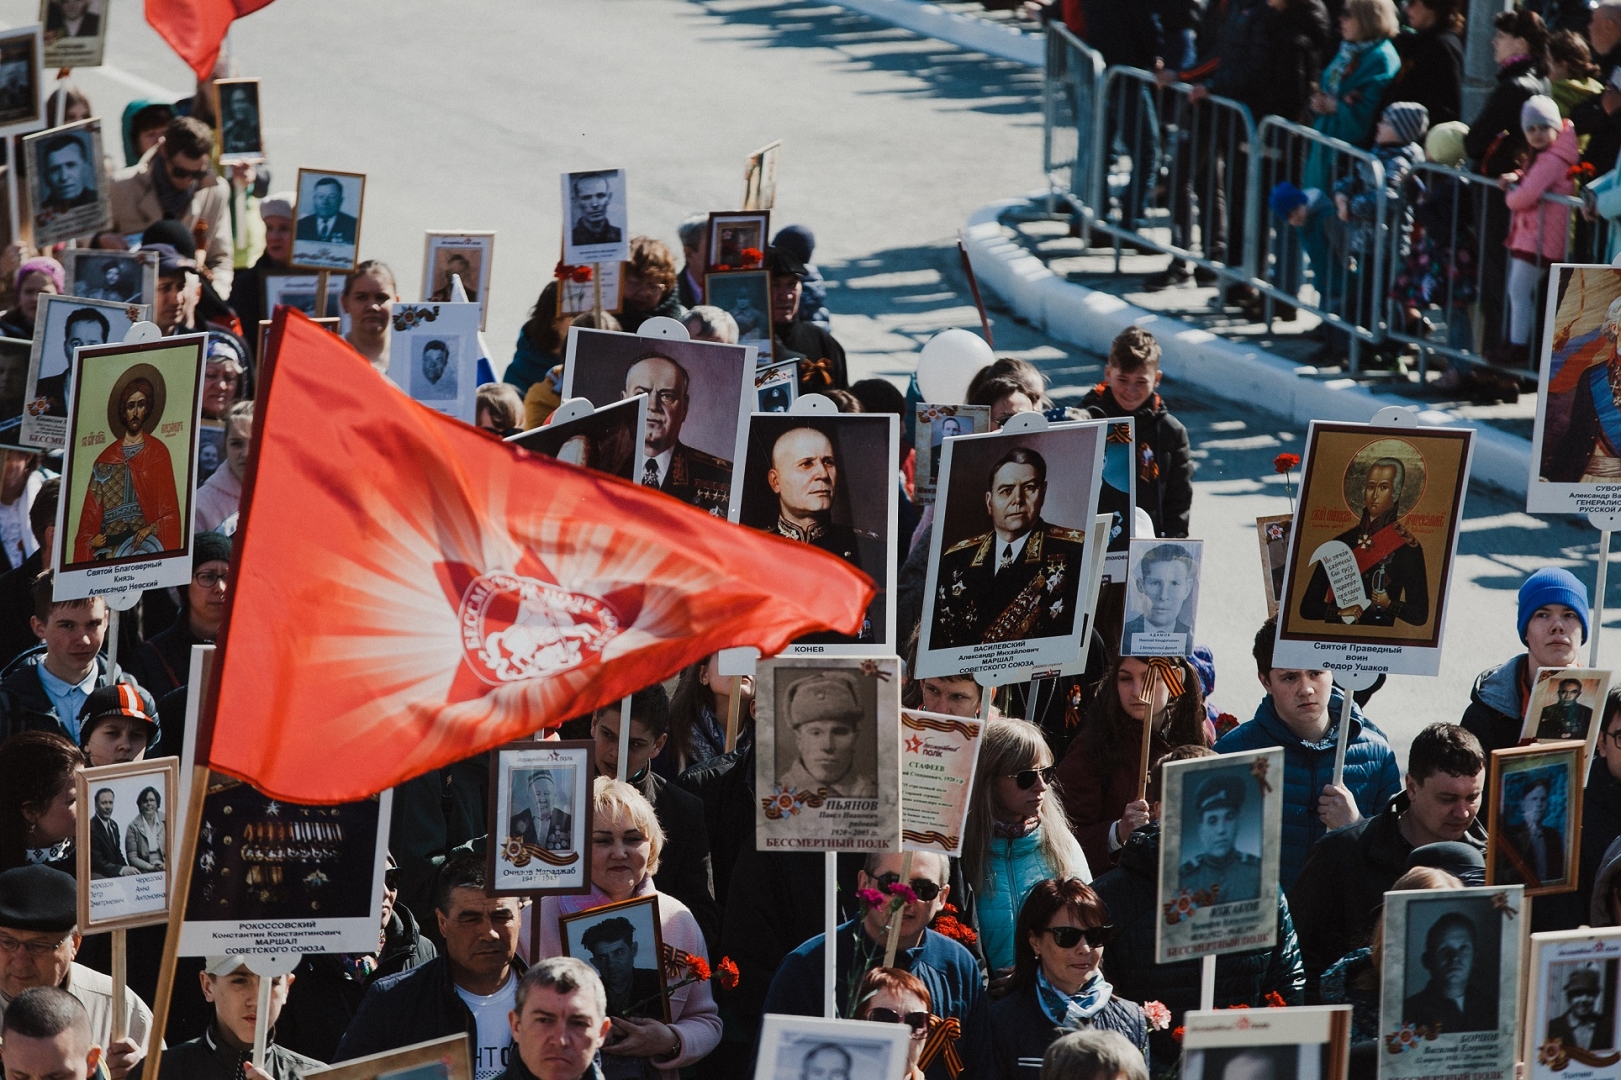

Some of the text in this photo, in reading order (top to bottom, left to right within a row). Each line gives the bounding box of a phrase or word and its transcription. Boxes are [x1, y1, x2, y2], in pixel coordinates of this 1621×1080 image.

[87, 560, 162, 577] Святой Благоверный
[114, 575, 135, 583] Князь
[88, 580, 158, 596] Александр Невский
[974, 641, 1026, 652] ВАСИЛЕВСКИЙ
[1314, 642, 1402, 654] Святой Праведный
[958, 647, 1040, 661] Александр Михайлович
[982, 656, 1014, 664] МАРШАЛ
[959, 664, 1006, 674] СОВЕТСКОГО
[1322, 662, 1388, 672] Федор Ушаков
[908, 762, 945, 772] СТАФЕЕВ
[826, 800, 878, 811] ПЬЯНОВ
[766, 838, 890, 849] БЕССМЕРТНЫЙ ПОЛК
[536, 867, 576, 877] Мараджаб
[238, 920, 316, 930] РОКОССОВСКИЙ
[267, 930, 341, 938] Константинович
